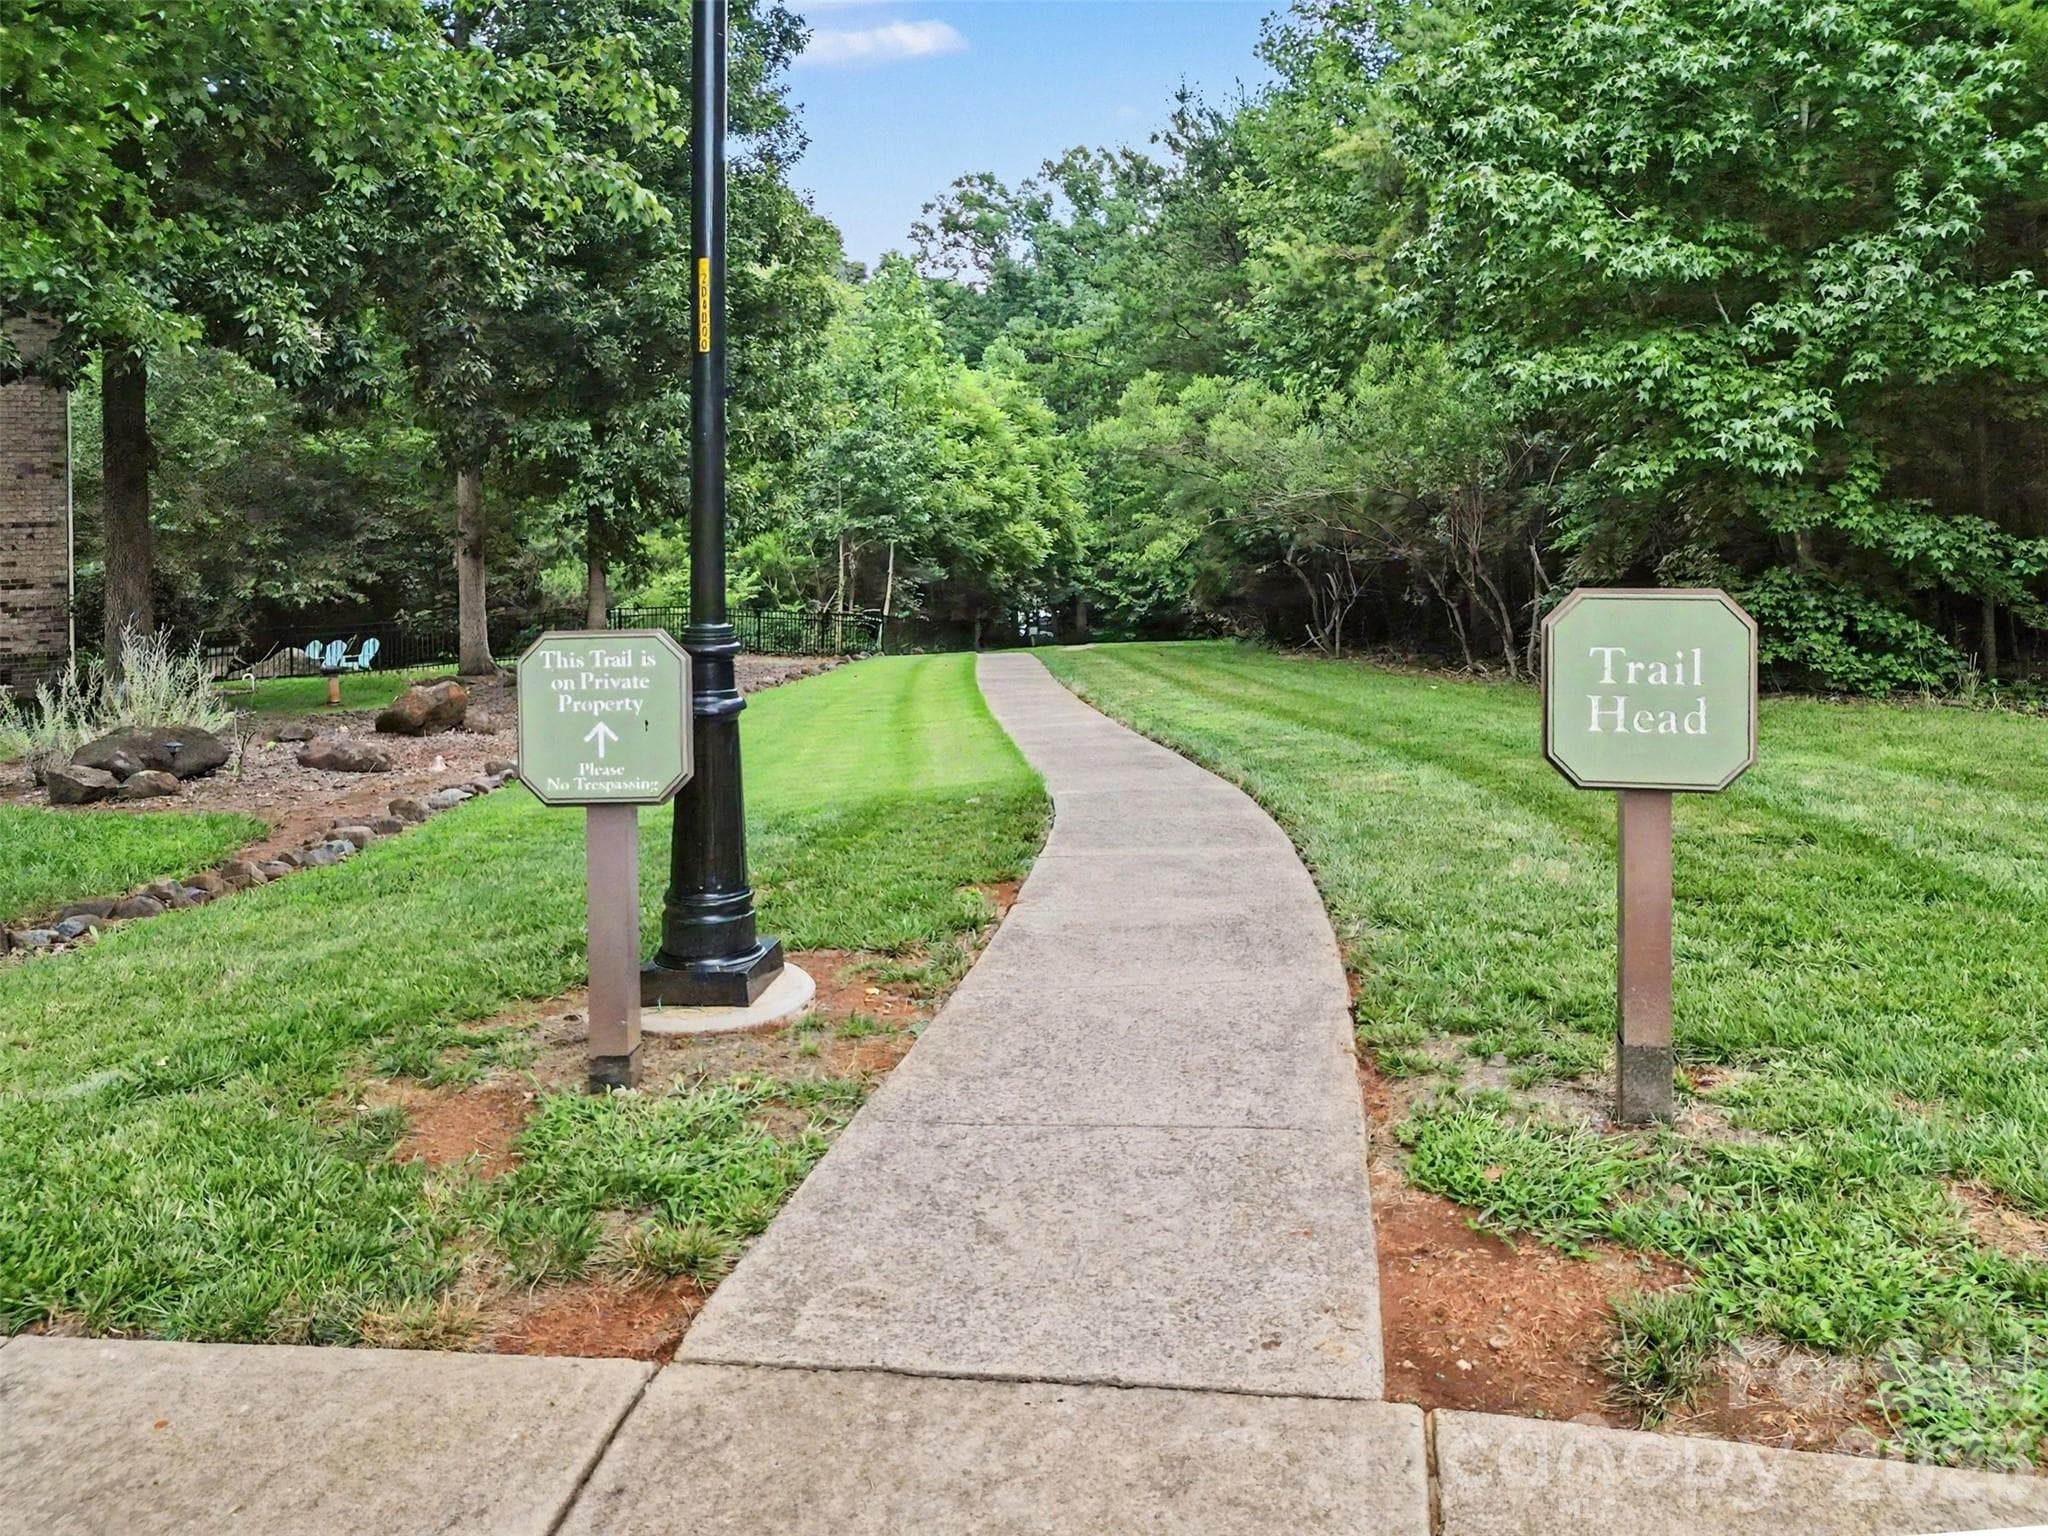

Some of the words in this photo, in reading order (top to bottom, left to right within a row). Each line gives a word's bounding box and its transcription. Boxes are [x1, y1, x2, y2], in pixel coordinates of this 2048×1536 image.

[540, 650, 585, 669] This
[588, 649, 633, 668] Trail
[640, 650, 657, 668] is
[1588, 646, 1702, 687] Trail
[551, 678, 575, 691] on
[580, 672, 650, 690] Private
[558, 695, 644, 716] Property
[1586, 694, 1708, 735] Head
[579, 762, 625, 777] Please
[547, 777, 570, 791] No
[573, 776, 659, 793] Trespassing
